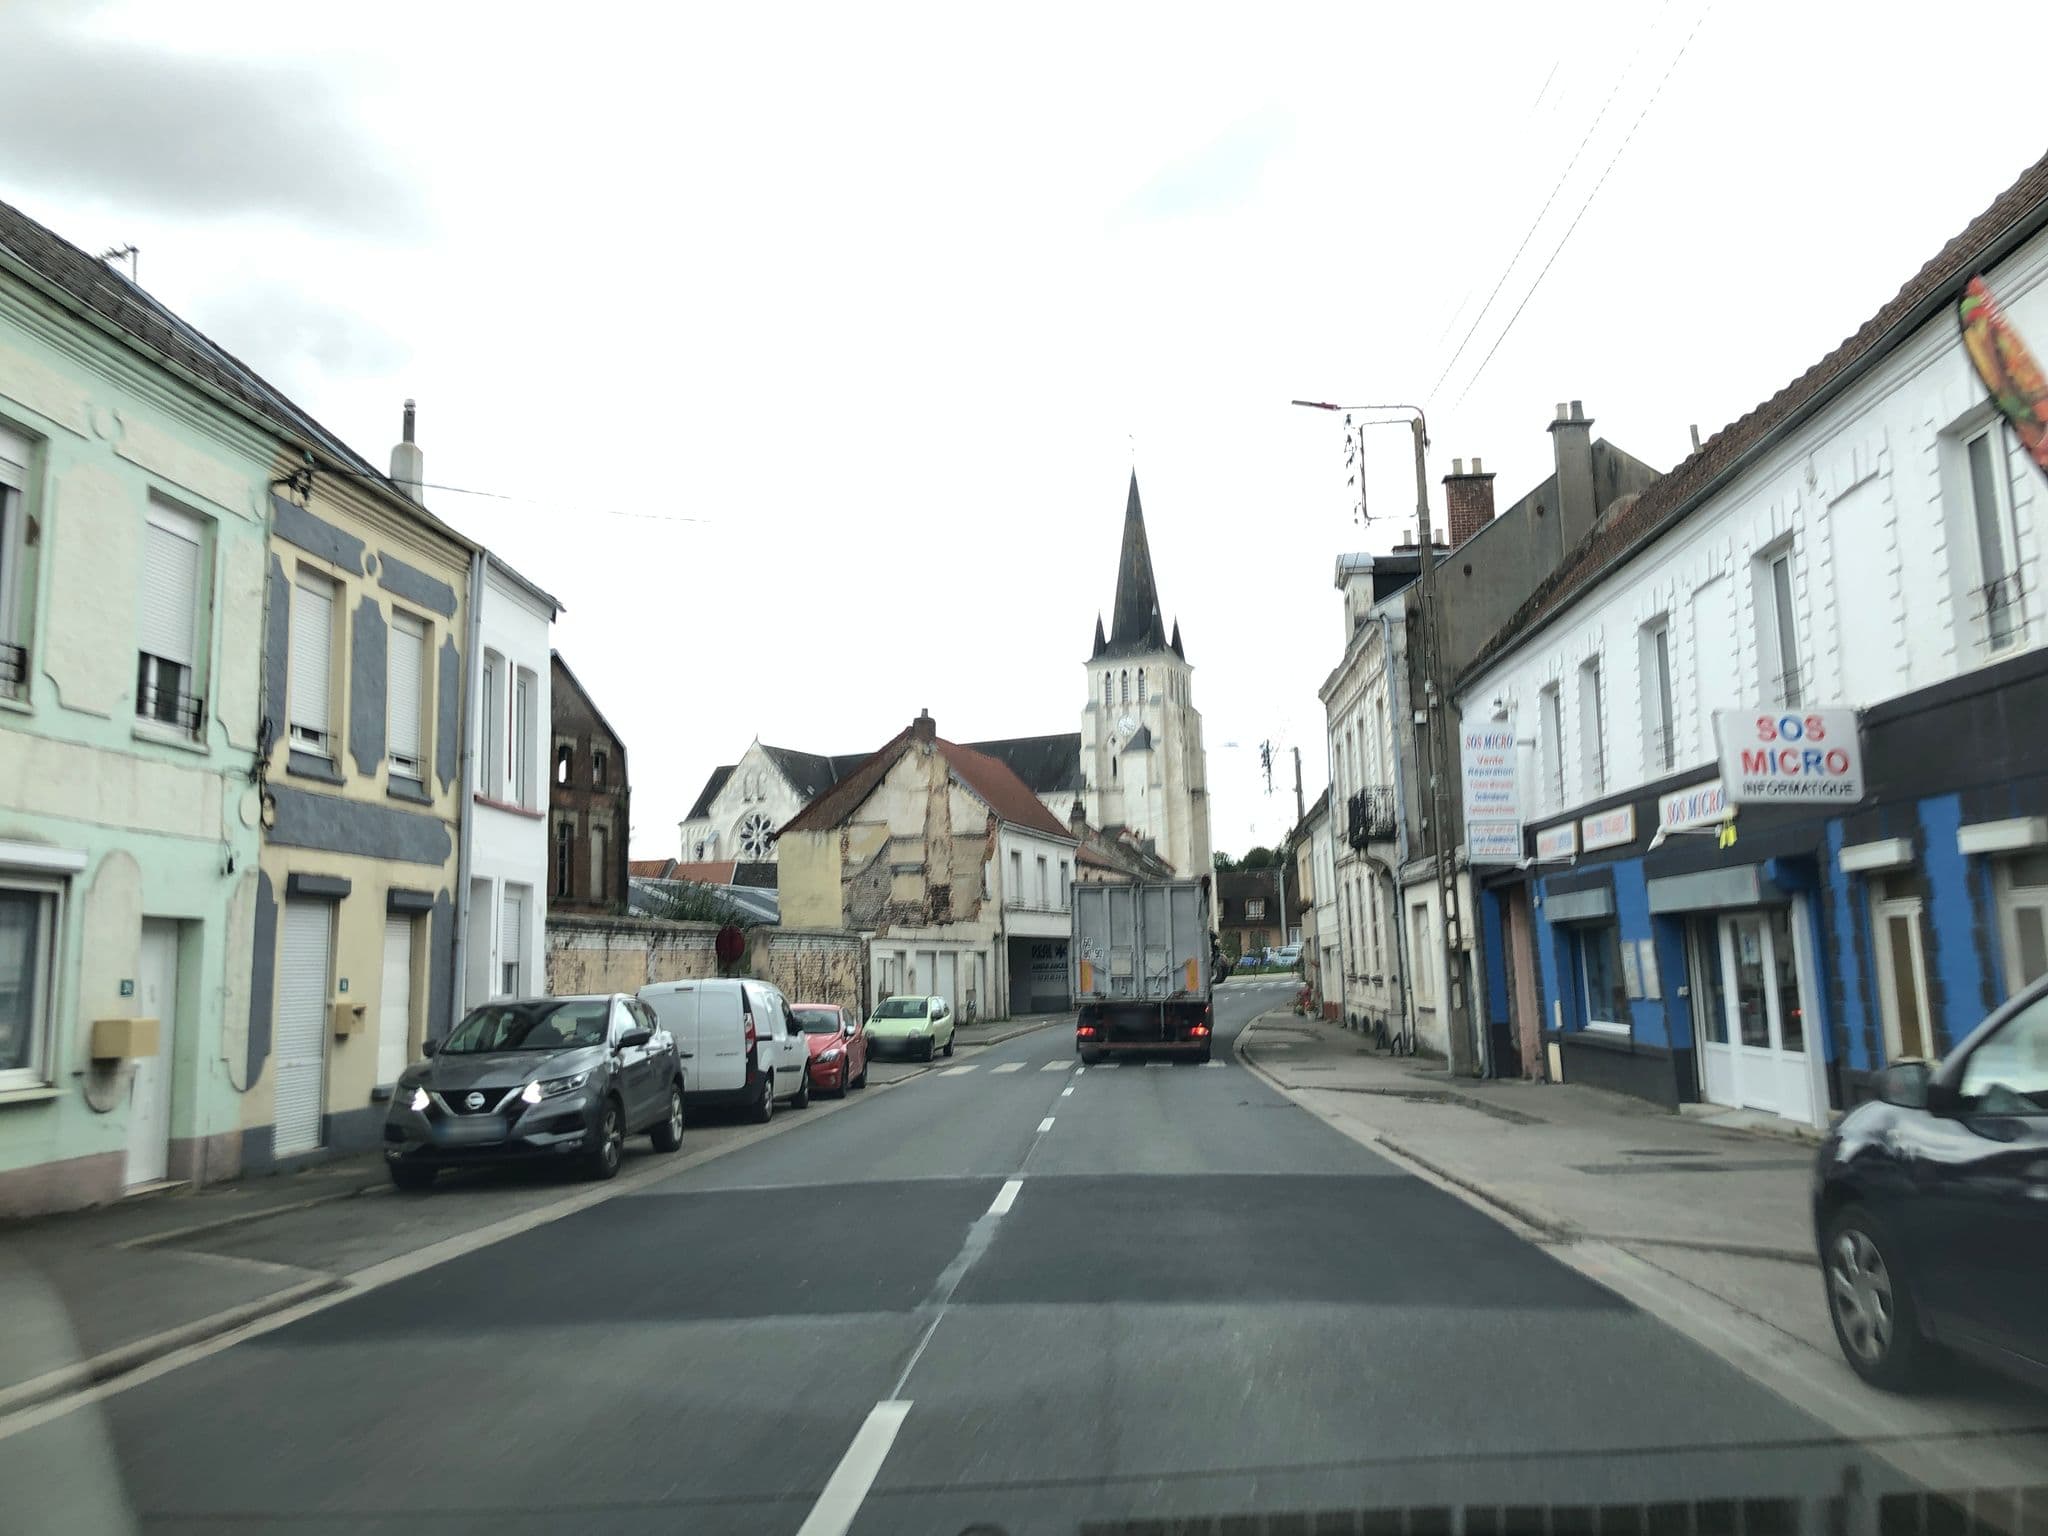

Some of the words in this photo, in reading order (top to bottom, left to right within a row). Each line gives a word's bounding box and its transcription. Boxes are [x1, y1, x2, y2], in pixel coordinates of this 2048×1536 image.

[1465, 735, 1482, 750] SOS
[1484, 733, 1513, 750] MICRO
[1756, 715, 1825, 742] SOS
[1741, 748, 1849, 776] MICRO
[1743, 781, 1856, 796] INFORMATIQUE
[1667, 800, 1685, 825] SOS
[1688, 785, 1726, 820] MICRO
